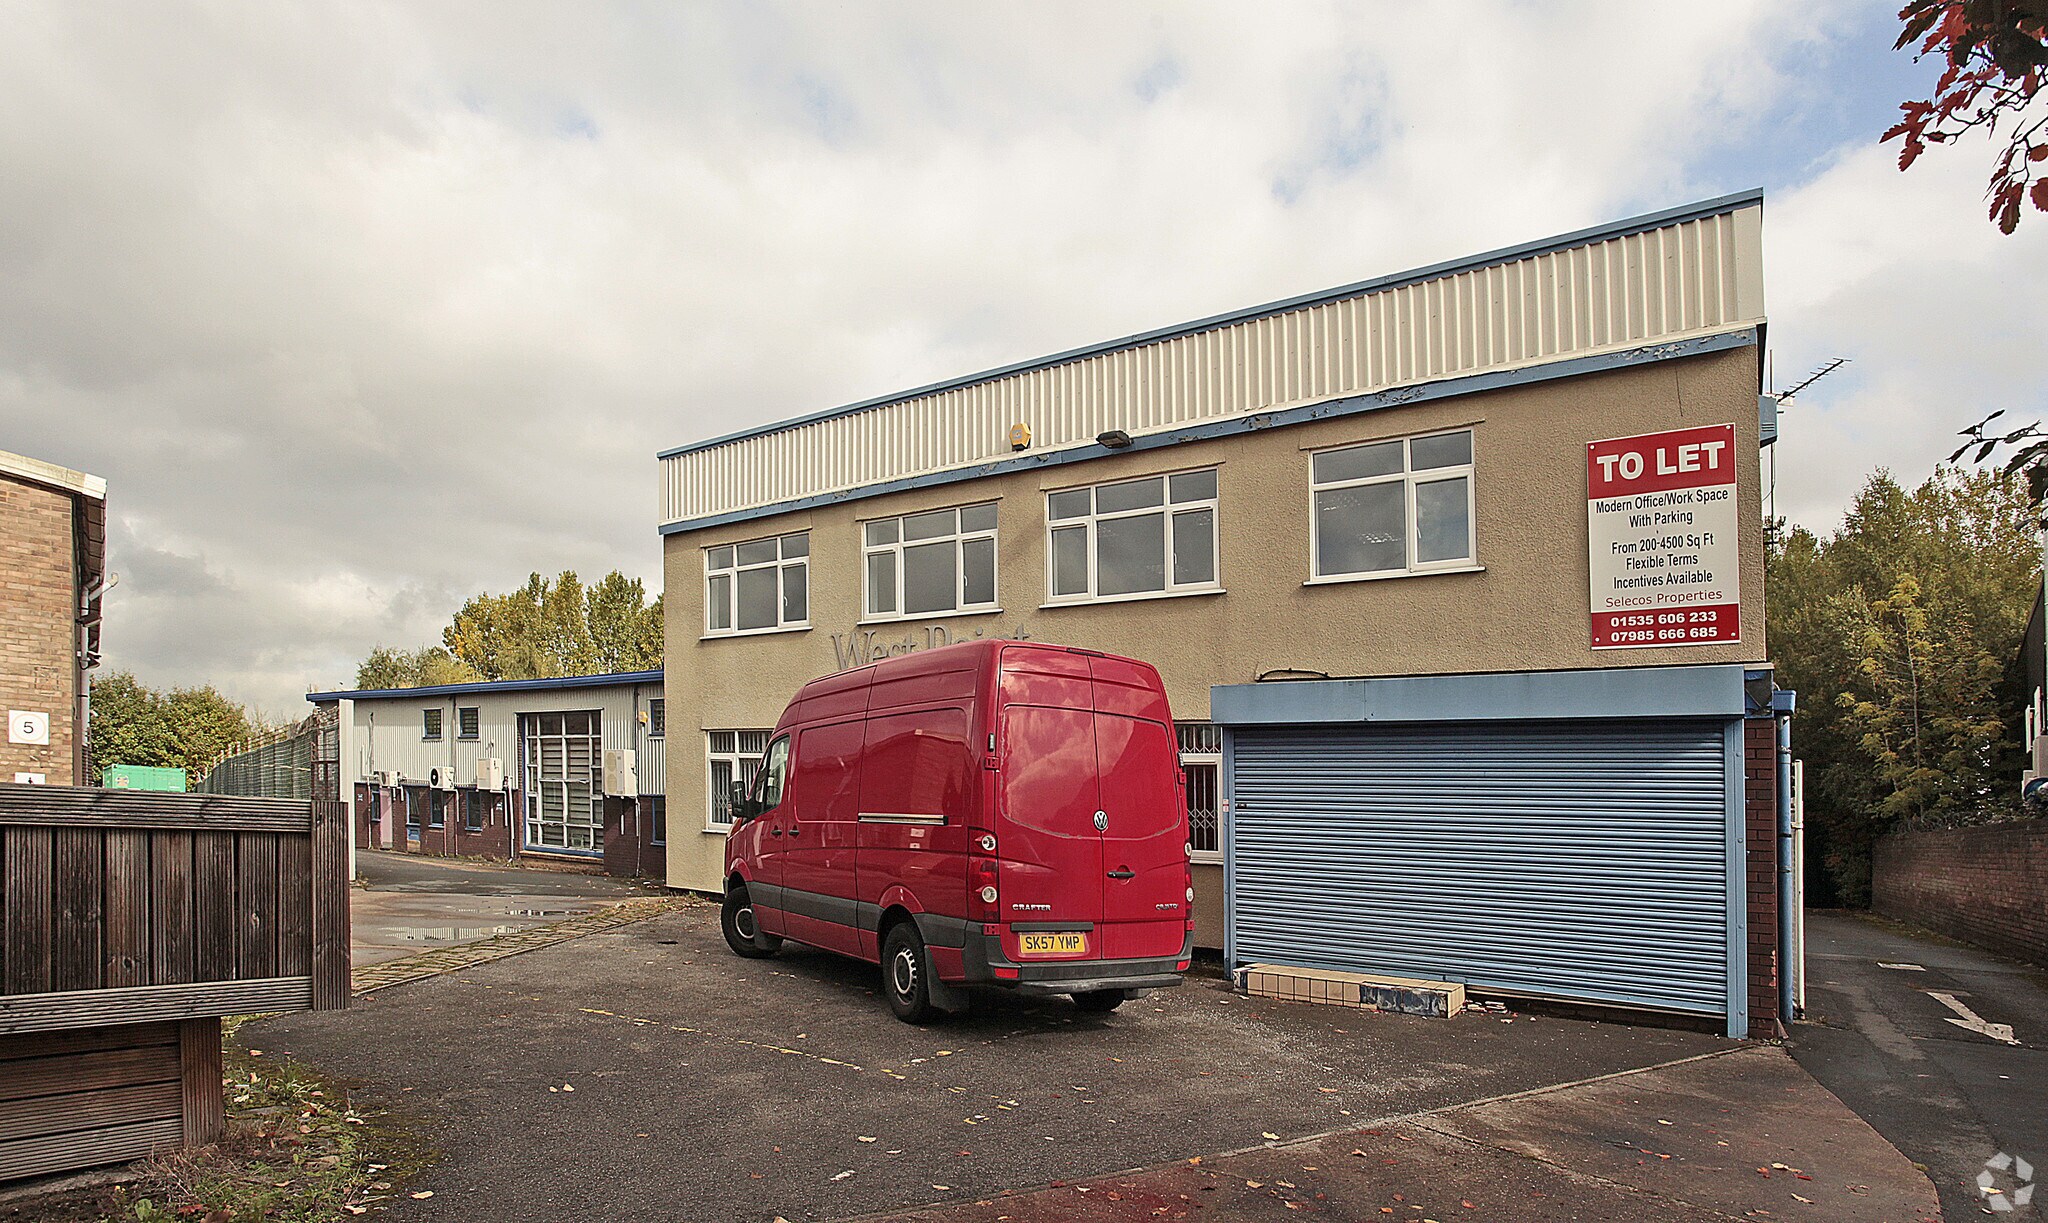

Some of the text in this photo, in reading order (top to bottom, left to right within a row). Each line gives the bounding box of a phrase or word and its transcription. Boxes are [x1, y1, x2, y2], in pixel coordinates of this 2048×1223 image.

[1596, 440, 1726, 483] TO LET
[1596, 489, 1728, 513] Modern Office/Work Space
[1629, 510, 1693, 528] With Parking
[1612, 532, 1714, 554] From 200-4500 Sq Ft
[1626, 553, 1699, 571] Flexible Terms
[1613, 569, 1713, 590] Incentives Available
[1605, 590, 1723, 607] Selecos Properties
[1610, 611, 1717, 628] 01535 606 233
[1610, 626, 1718, 643] 07985 666 685
[23, 721, 34, 734] 5
[1012, 903, 1052, 911] CRAFTER
[1025, 935, 1080, 950] SK57 YMP
